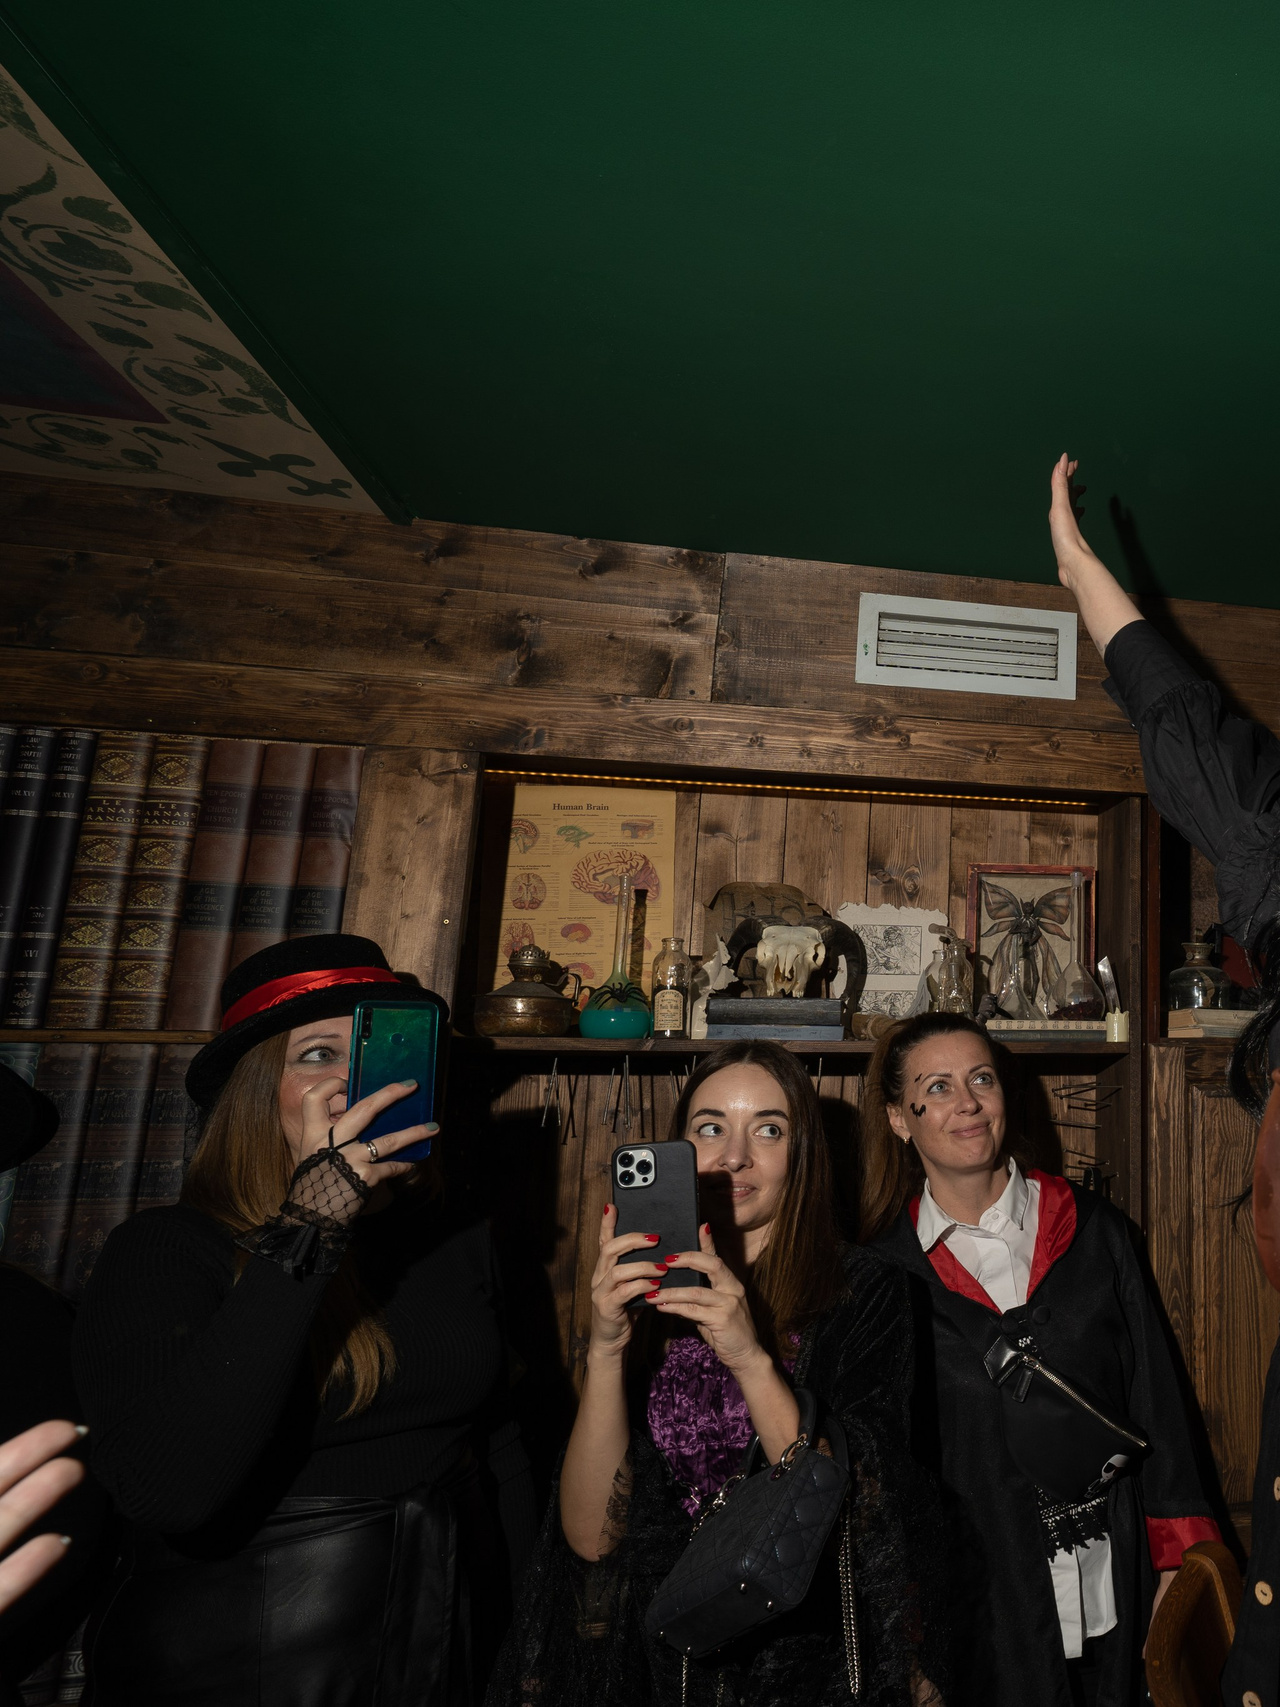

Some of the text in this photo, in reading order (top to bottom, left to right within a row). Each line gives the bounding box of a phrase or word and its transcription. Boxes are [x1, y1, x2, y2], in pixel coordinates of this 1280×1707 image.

[20, 750, 42, 758] SOUTH
[60, 752, 82, 760] SOUTH
[17, 762, 40, 771] AFRICA
[206, 789, 247, 799] TEN EPOCHS
[261, 792, 301, 802] TEN EPOCHS
[207, 805, 239, 815] CHURCH
[552, 803, 609, 812] Human Brain
[262, 808, 293, 818] CHURCH
[204, 816, 238, 825] HISTORY
[259, 818, 292, 828] HISTORY
[200, 887, 217, 895] AGE
[255, 889, 272, 898] AGE
[305, 891, 322, 899] AGE
[260, 898, 274, 906] THE
[22, 949, 40, 958] XVI
